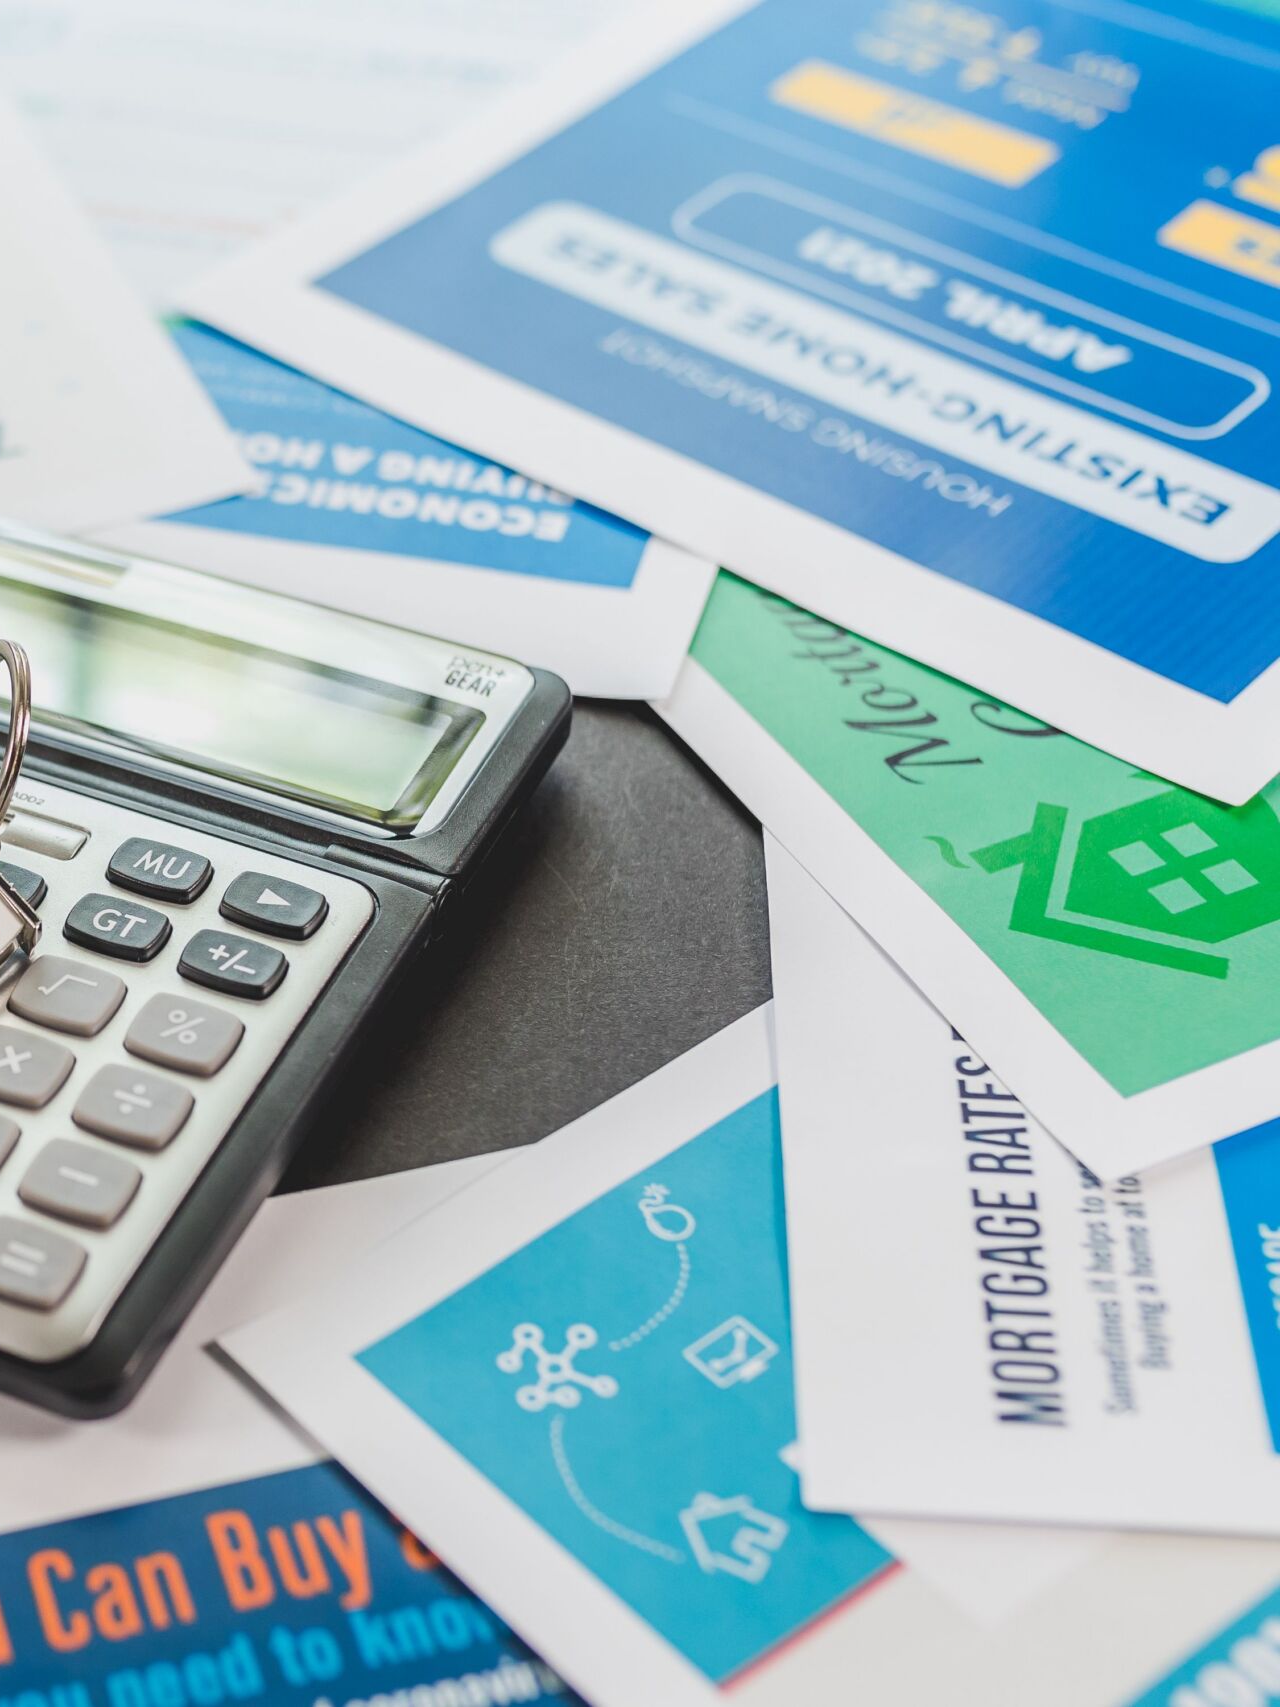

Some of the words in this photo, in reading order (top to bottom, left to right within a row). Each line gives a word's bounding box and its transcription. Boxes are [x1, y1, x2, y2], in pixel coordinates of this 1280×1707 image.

[550, 232, 714, 316] SALES
[945, 277, 1134, 374] APRIL
[600, 329, 815, 432] SNAPSHOT
[729, 304, 1231, 527] EXISTING-HOME
[236, 430, 326, 470] HO
[332, 442, 373, 476] A
[810, 416, 1014, 518] HOUSING
[444, 670, 497, 698] GEAR
[132, 849, 194, 881] MU
[93, 908, 148, 939] GT
[159, 1008, 206, 1045] %
[1078, 1194, 1106, 1216] to
[1116, 1196, 1148, 1220] at
[1080, 1219, 1117, 1274] helps
[1124, 1230, 1158, 1279] home
[970, 1187, 1069, 1429] MORTGAGE
[1087, 1271, 1116, 1293] it
[1136, 1283, 1159, 1298] a
[1101, 1299, 1137, 1417] Sometimes
[1137, 1301, 1172, 1371] Buying
[26, 1547, 198, 1653] Can
[203, 1508, 373, 1612] Buy
[267, 1624, 345, 1684] to
